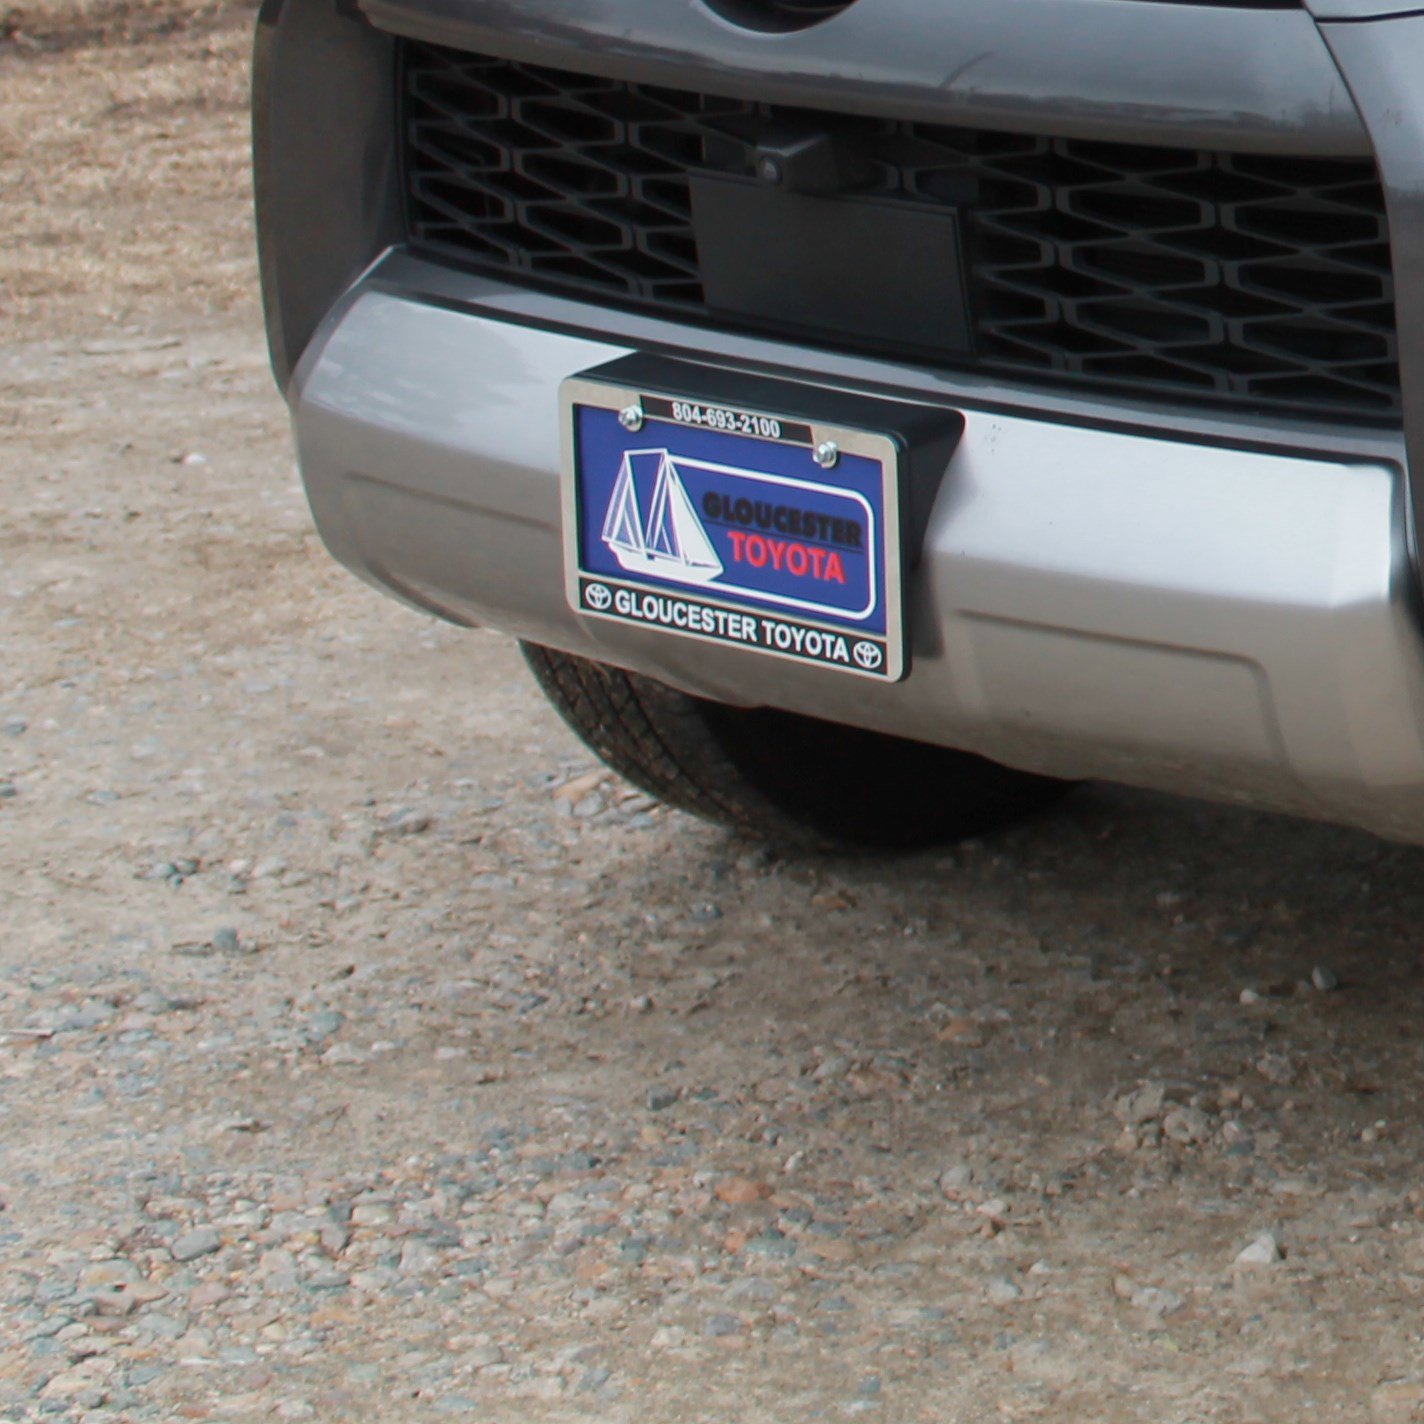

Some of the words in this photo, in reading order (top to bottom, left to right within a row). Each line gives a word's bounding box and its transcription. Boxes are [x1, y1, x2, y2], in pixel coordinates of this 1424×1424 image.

[671, 400, 782, 439] 804-693-2100
[702, 490, 863, 547] GLOUCESTER
[727, 530, 846, 585] TOYOTA
[614, 588, 758, 643] GLOUCESTER
[761, 619, 850, 663] TOYOTA
